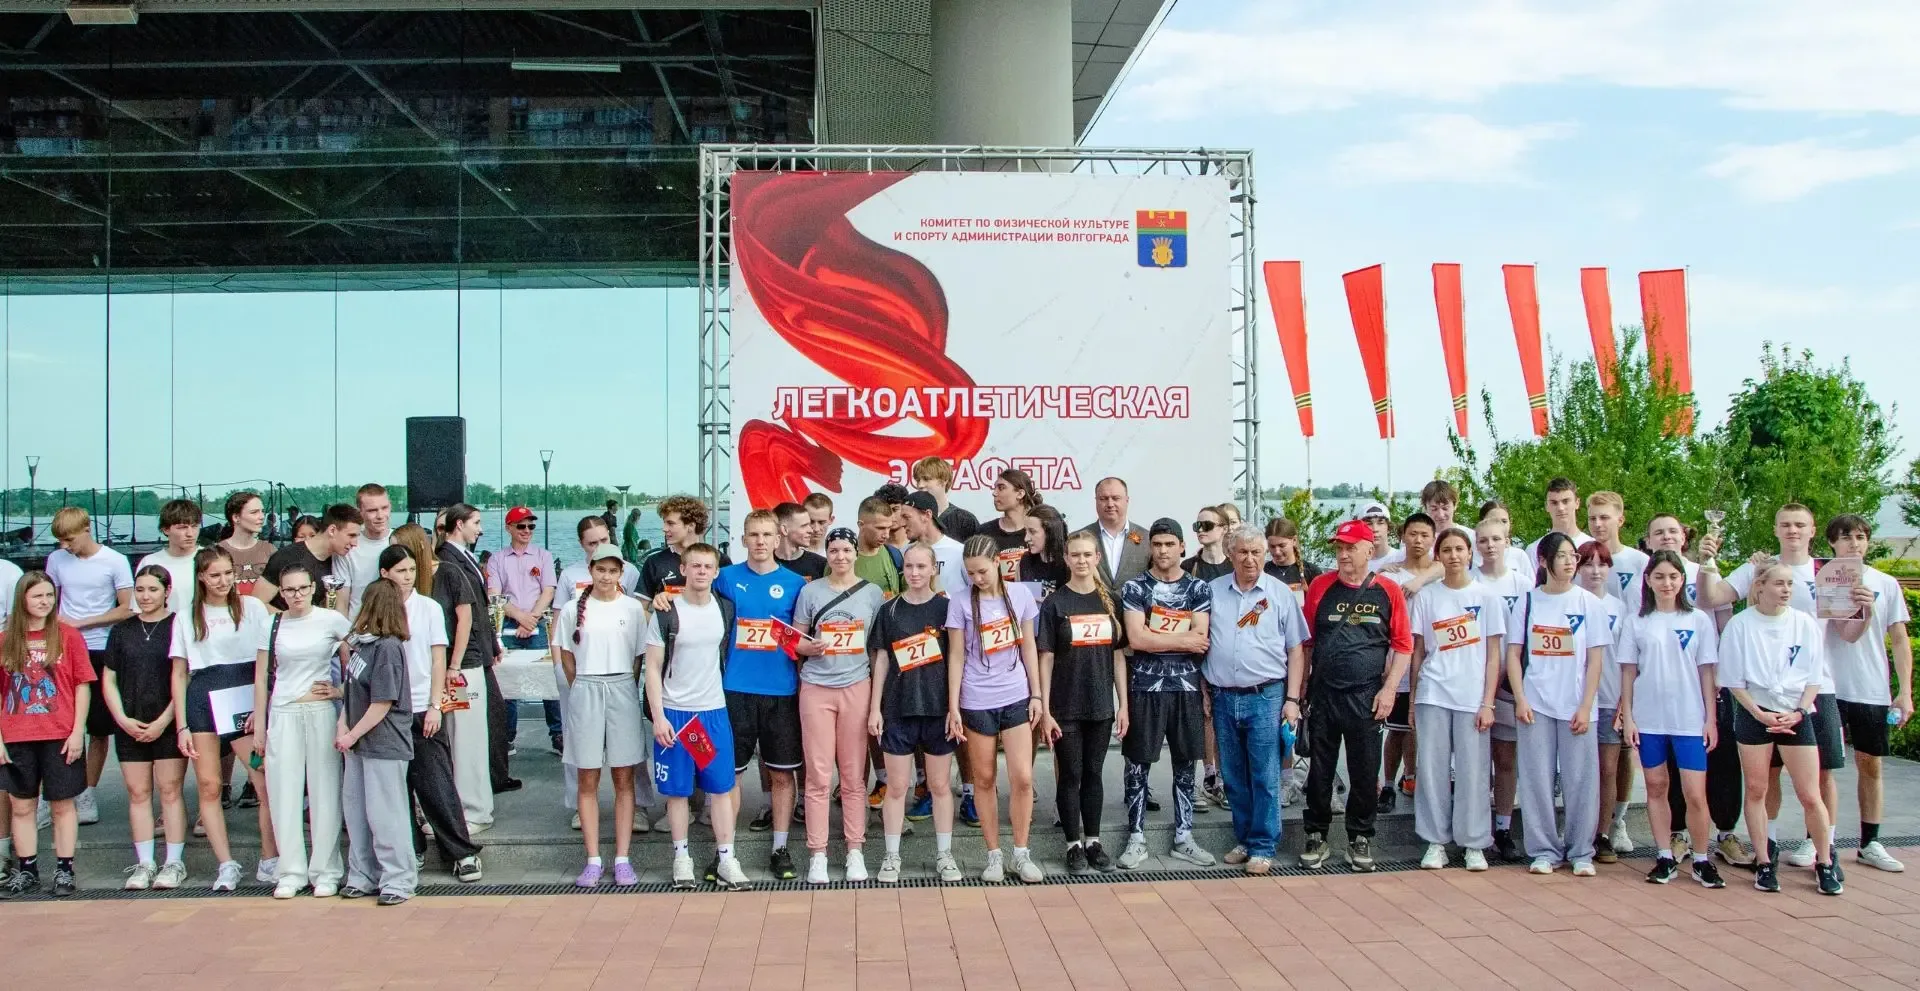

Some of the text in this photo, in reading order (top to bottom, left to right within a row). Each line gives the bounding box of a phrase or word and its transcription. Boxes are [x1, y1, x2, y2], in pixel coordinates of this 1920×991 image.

[920, 218, 1130, 230] КОМИТЕТ ПО ФИЗИЧЕСКОЙ КУЛЬТУРЕ
[894, 231, 1130, 243] И СПОРТУ АДМИНИСТРАЦИИ ВОЛГОГРАДА
[772, 386, 1189, 420] ЛЕГКОАТЛЕТИЧЕСКАЯ
[1336, 602, 1376, 613] GCCI
[1082, 623, 1101, 638] 27
[1159, 617, 1181, 632] 27
[746, 628, 768, 643] 27
[833, 633, 854, 647] 27
[991, 627, 1010, 645] 27
[1446, 624, 1467, 642] 30
[1541, 635, 1562, 650] 30
[907, 642, 927, 661] 27
